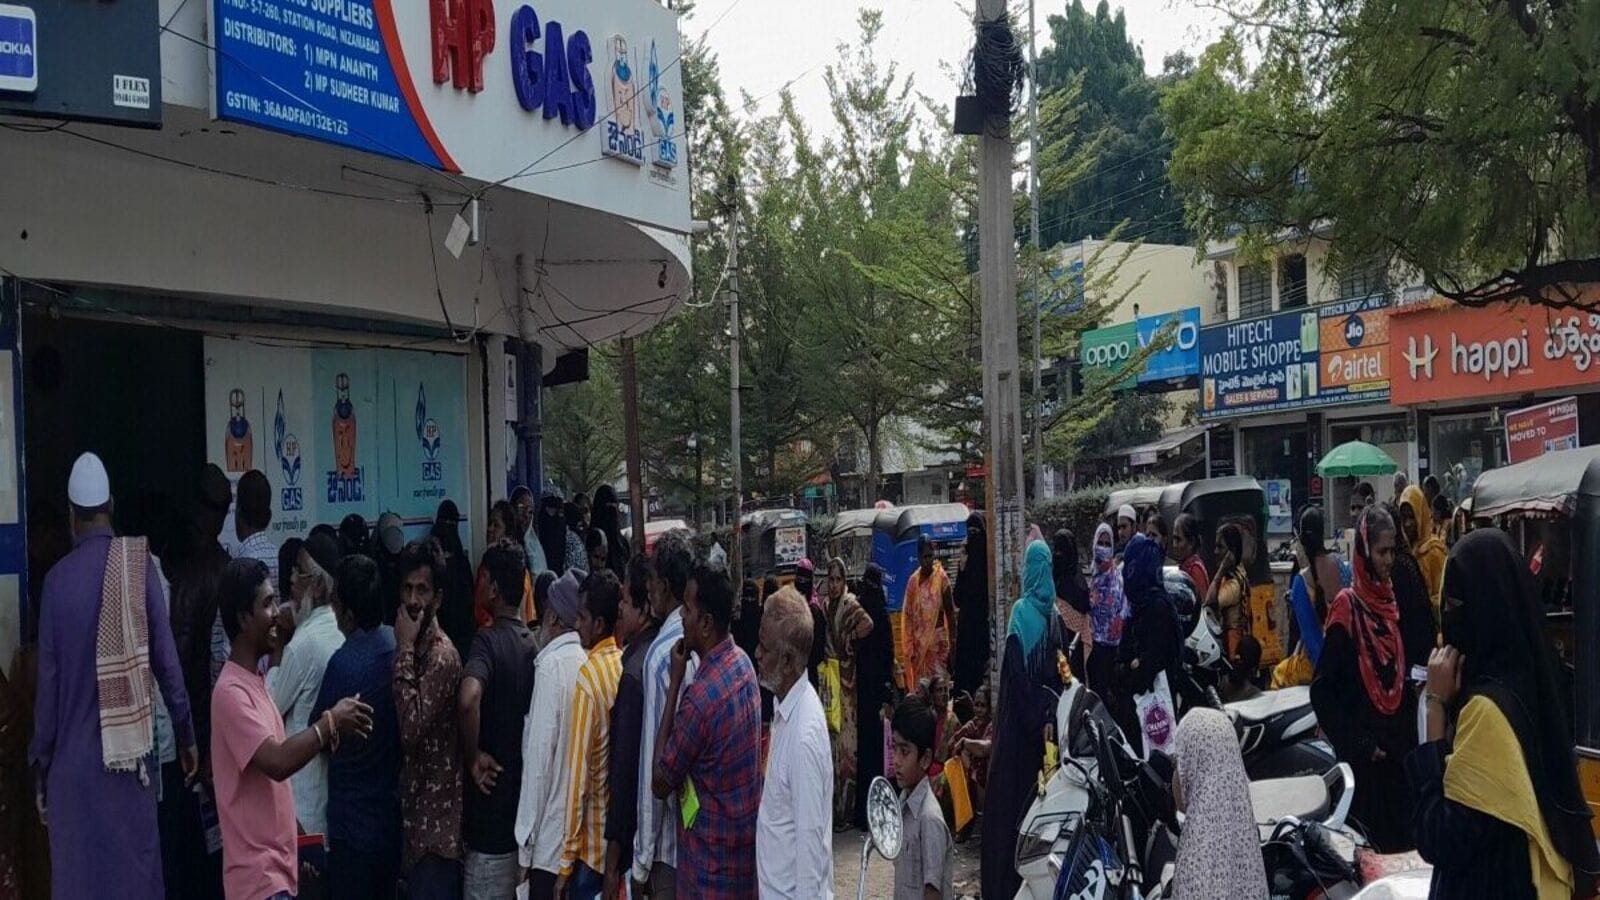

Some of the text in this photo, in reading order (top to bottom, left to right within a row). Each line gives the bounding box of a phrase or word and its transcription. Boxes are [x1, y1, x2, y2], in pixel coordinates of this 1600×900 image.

[282, 8, 316, 33] STATION
[0, 41, 32, 56] OKIA
[223, 17, 297, 57] DISTRIBUTORS:
[315, 46, 337, 69] MPN
[339, 54, 379, 82] ANANTH
[430, 0, 597, 131] HP GAS
[122, 79, 147, 92] FLEX
[314, 73, 328, 92] MP
[330, 78, 370, 106] SUDHEER
[371, 90, 400, 113] KUMAR
[226, 91, 261, 113] GSTIN:
[1227, 319, 1273, 347] HITECH
[1346, 321, 1364, 338] Jio
[1086, 340, 1130, 367] oppo
[1203, 349, 1248, 375] MOBILE
[1251, 340, 1301, 366] SHOPPE
[1344, 351, 1382, 379] airtel
[1451, 329, 1529, 382] happi
[1226, 392, 1244, 404] SALES
[1250, 389, 1278, 401] SERVICES
[1510, 426, 1546, 442] MOVED TO
[285, 440, 297, 456] HP
[423, 463, 441, 480] GAS
[282, 489, 303, 510] GAS
